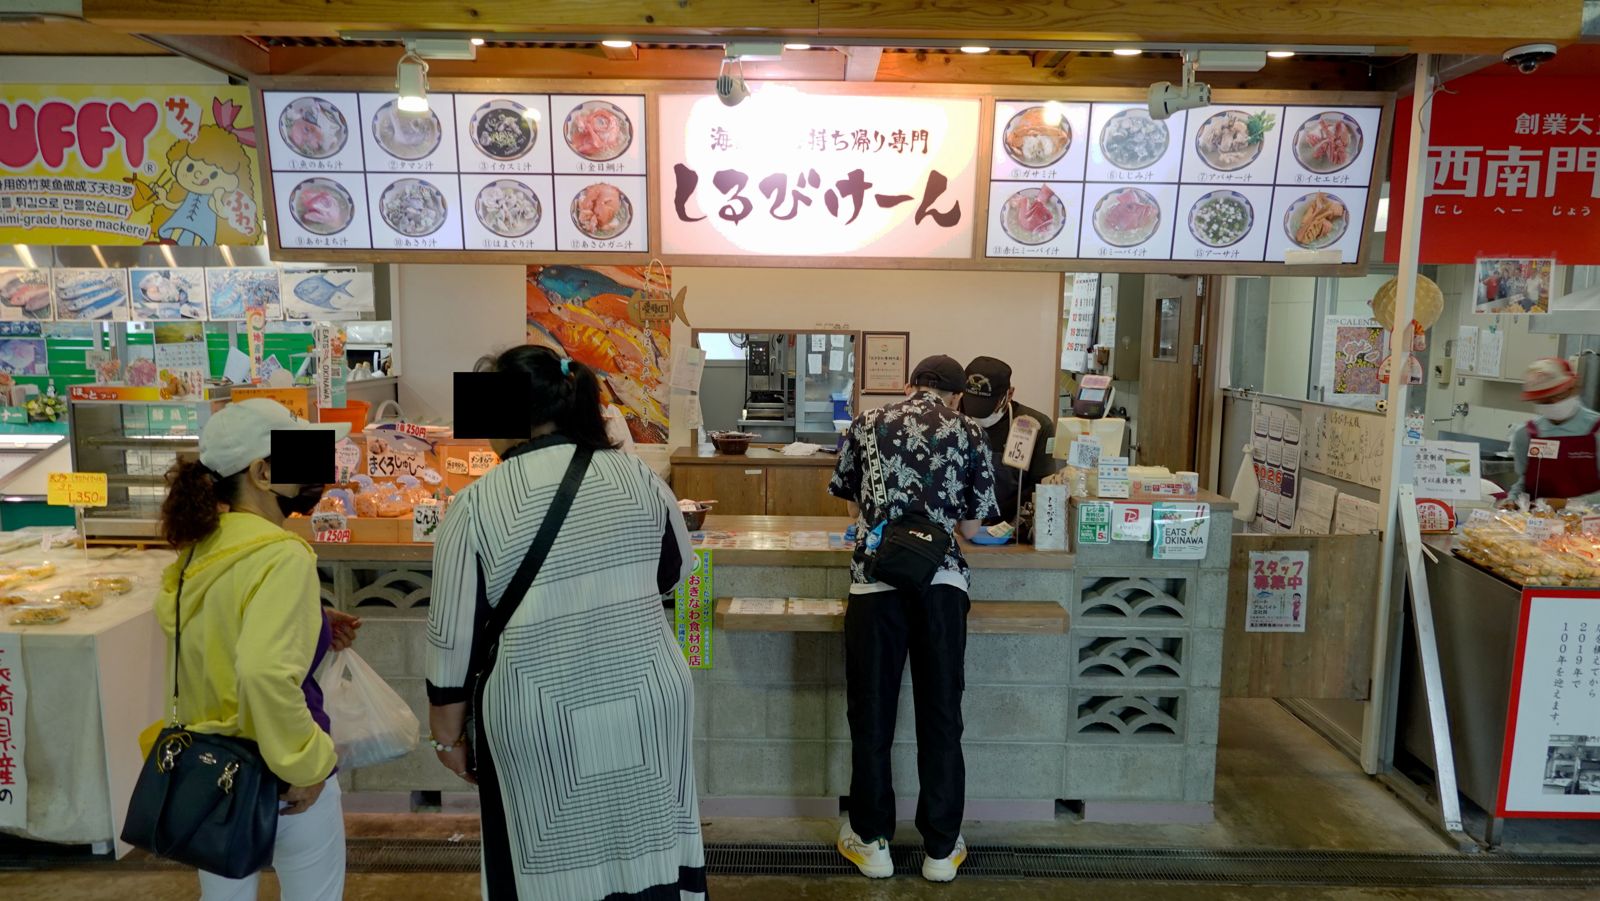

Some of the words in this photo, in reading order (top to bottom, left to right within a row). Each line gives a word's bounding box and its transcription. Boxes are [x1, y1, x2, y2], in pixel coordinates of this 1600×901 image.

[1515, 113, 1600, 135] 創業大
[1424, 145, 1600, 199] 西南門
[674, 163, 961, 227] しるびけーん
[1434, 204, 1463, 215] にし
[1552, 206, 1591, 216] じょう
[60, 214, 93, 227] horse
[95, 218, 149, 237] mackerel
[322, 364, 330, 399] OKINAWA
[867, 433, 876, 456] FILA
[870, 459, 881, 481] FILA
[874, 483, 885, 505] FILA
[327, 530, 350, 542] 250円
[908, 530, 933, 542] FILA
[1165, 527, 1187, 537] EATS
[1165, 536, 1204, 545] OKINAWA
[1254, 560, 1304, 576] スタッフ
[688, 574, 701, 667] おきなわ食材の店
[1572, 622, 1588, 689] 2019年で
